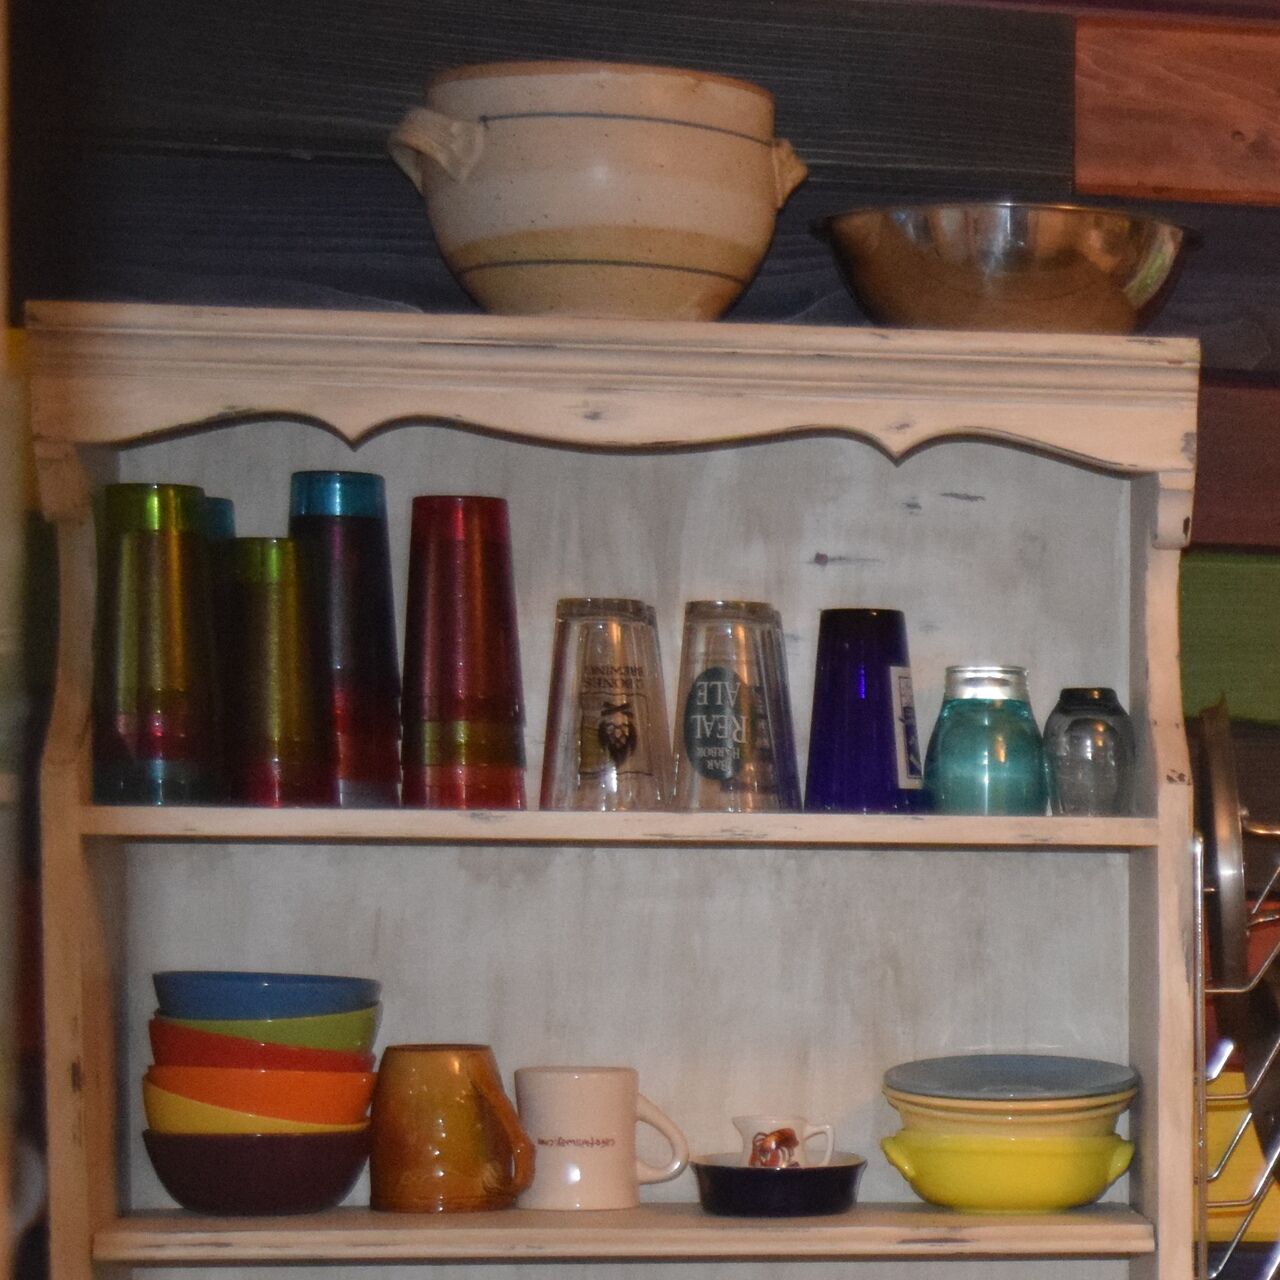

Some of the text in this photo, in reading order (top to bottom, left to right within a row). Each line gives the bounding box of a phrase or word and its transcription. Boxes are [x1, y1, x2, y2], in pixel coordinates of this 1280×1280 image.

[696, 681, 741, 706] ALE
[691, 714, 749, 743] REAL
[707, 759, 732, 771] BAR
